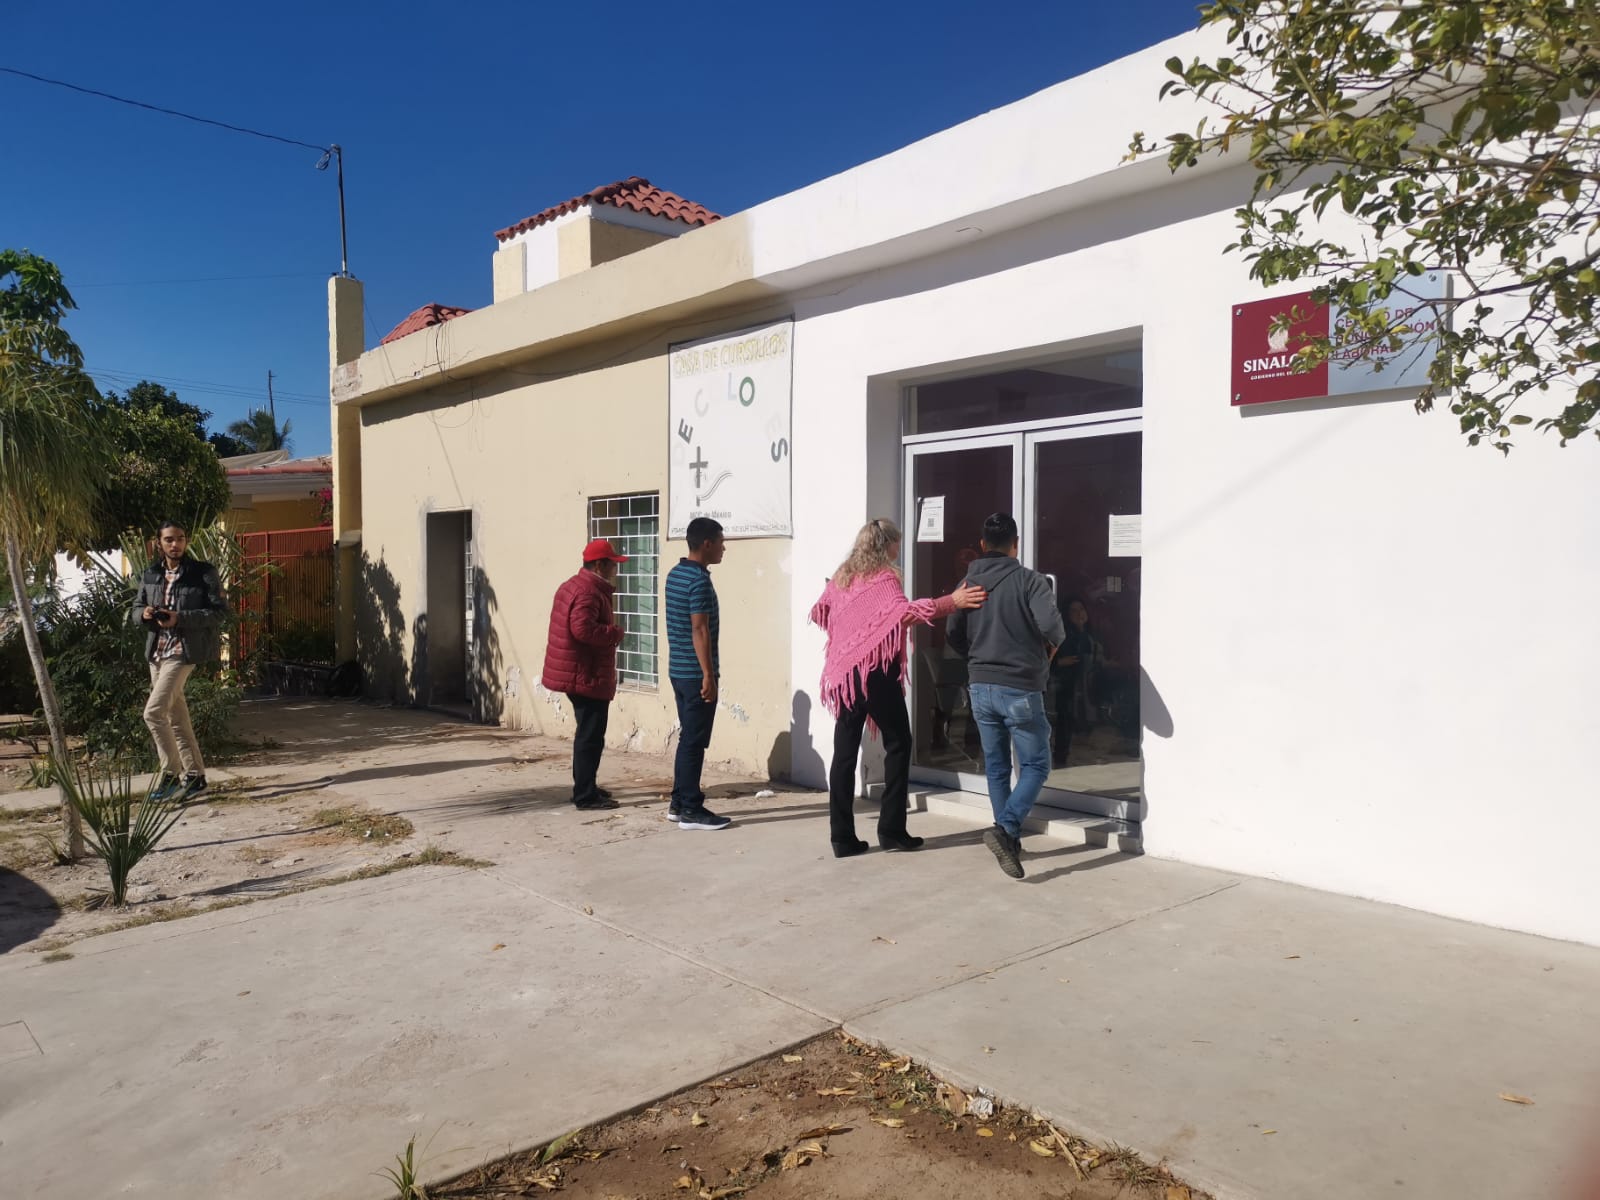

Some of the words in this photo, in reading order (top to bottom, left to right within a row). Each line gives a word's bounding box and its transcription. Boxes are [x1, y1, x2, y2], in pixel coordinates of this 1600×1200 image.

[674, 350, 701, 378] CASA
[703, 347, 718, 371] DE
[720, 333, 788, 367] CURSILLOS
